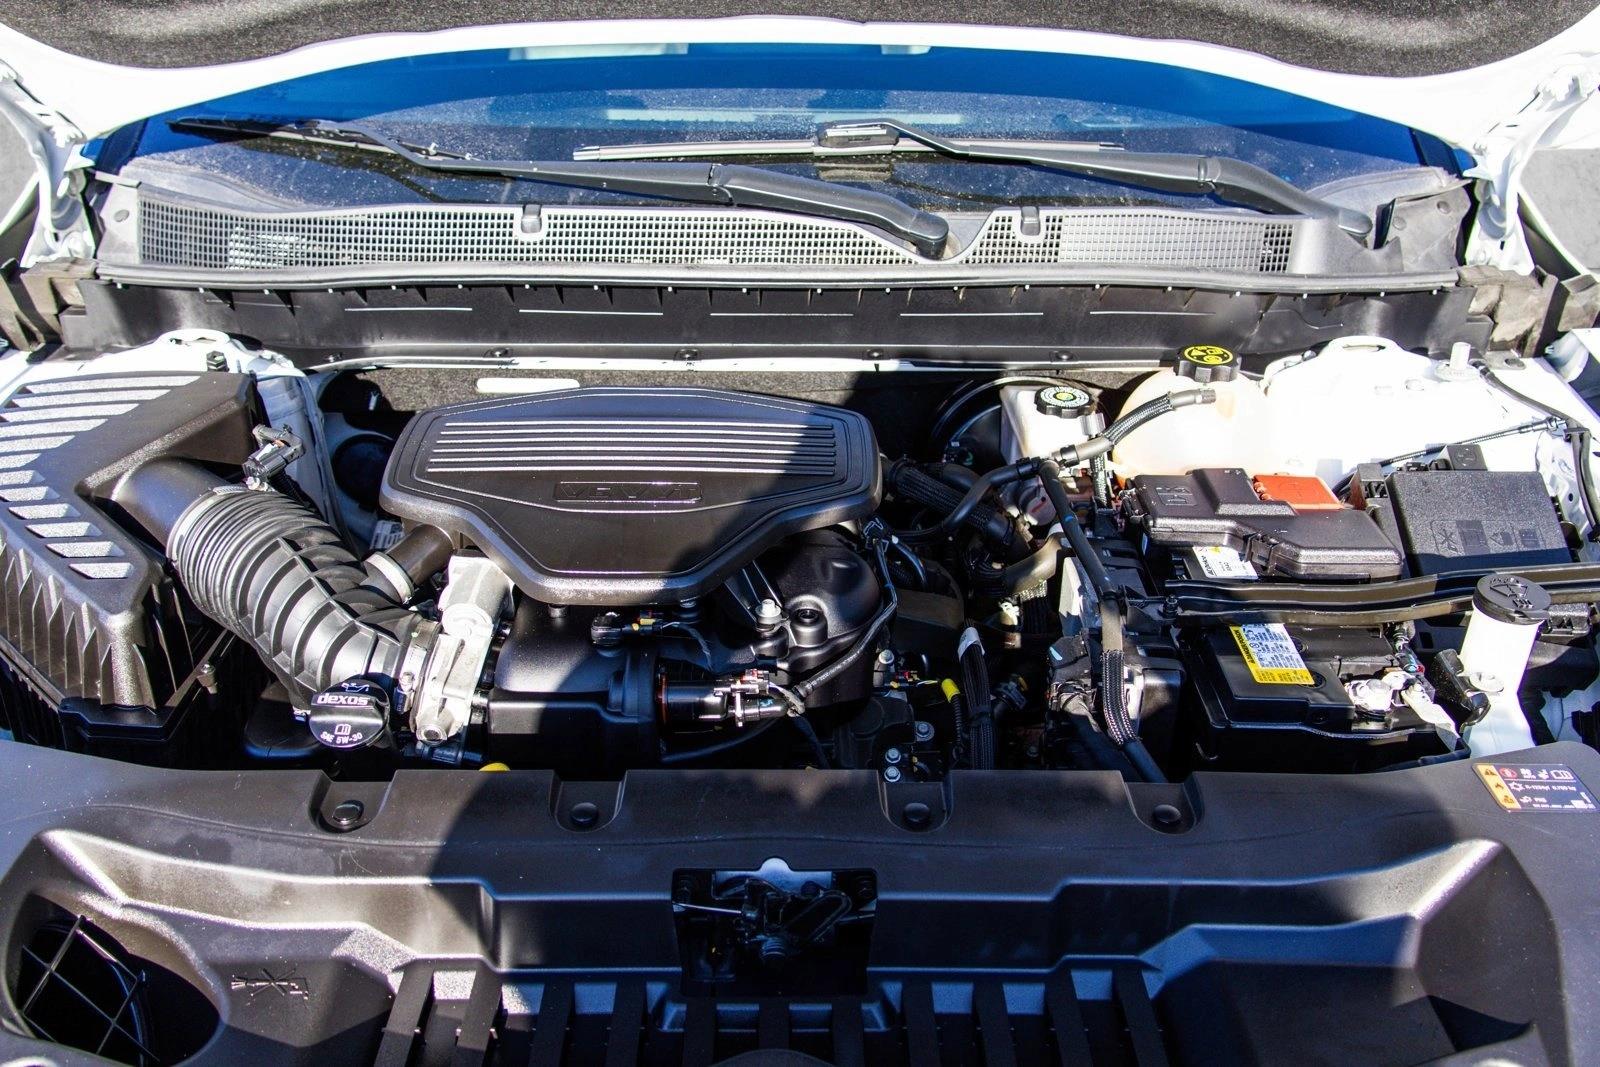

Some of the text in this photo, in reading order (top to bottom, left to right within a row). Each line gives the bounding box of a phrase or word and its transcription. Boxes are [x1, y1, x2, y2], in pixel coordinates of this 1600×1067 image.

[317, 693, 370, 705] dexos
[320, 731, 363, 744] SAE 5W-30
